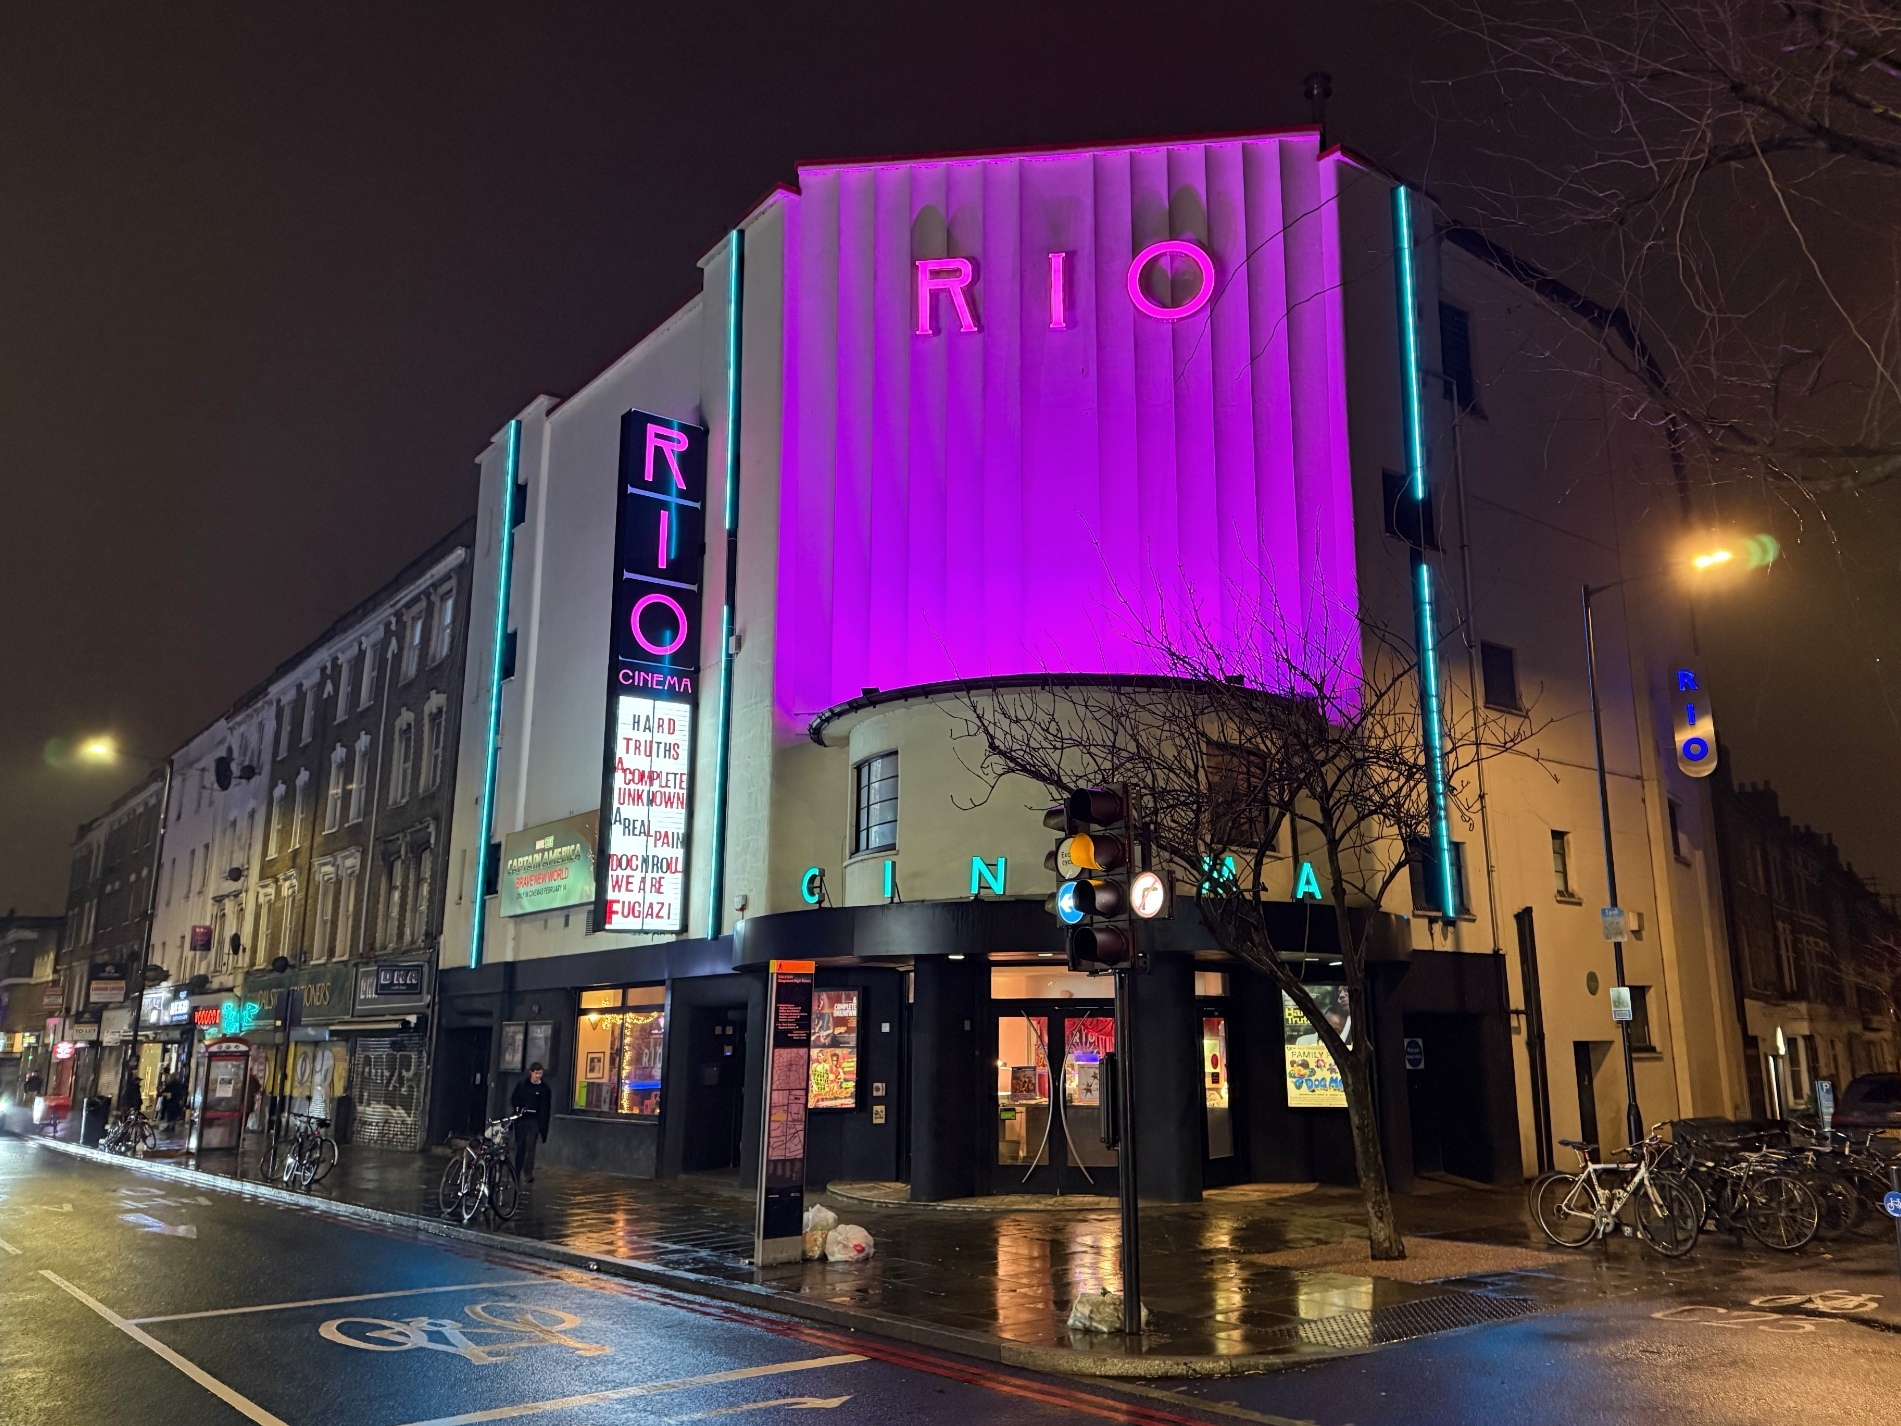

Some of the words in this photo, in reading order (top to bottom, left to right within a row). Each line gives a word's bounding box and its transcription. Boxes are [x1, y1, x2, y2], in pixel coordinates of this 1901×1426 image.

[916, 240, 1216, 335] RIO
[631, 423, 689, 655] RIO
[618, 668, 692, 693] CINEMA
[632, 714, 676, 735] HARD
[1677, 669, 1709, 761] RIO
[623, 737, 680, 760] TRUTHS
[624, 767, 687, 790] COMPLETE
[618, 787, 685, 809] UNKNOWN
[612, 806, 622, 825] A
[622, 818, 653, 837] REAL
[653, 830, 684, 849] PAIN
[507, 852, 542, 876] CAPTAIN
[541, 843, 581, 868] AMERICA
[515, 873, 535, 890] BRAVE
[534, 870, 548, 885] NEW
[547, 867, 570, 882] WORLD
[611, 874, 634, 893] WE
[638, 876, 665, 894] ARE
[801, 856, 1322, 904] CINMA
[605, 899, 671, 925] FUGAZI
[834, 1003, 857, 1011] COMPLETE
[642, 1048, 663, 1069] RIO
[1291, 1051, 1324, 1059] FAMILY
[1304, 1077, 1328, 1092] DOG
